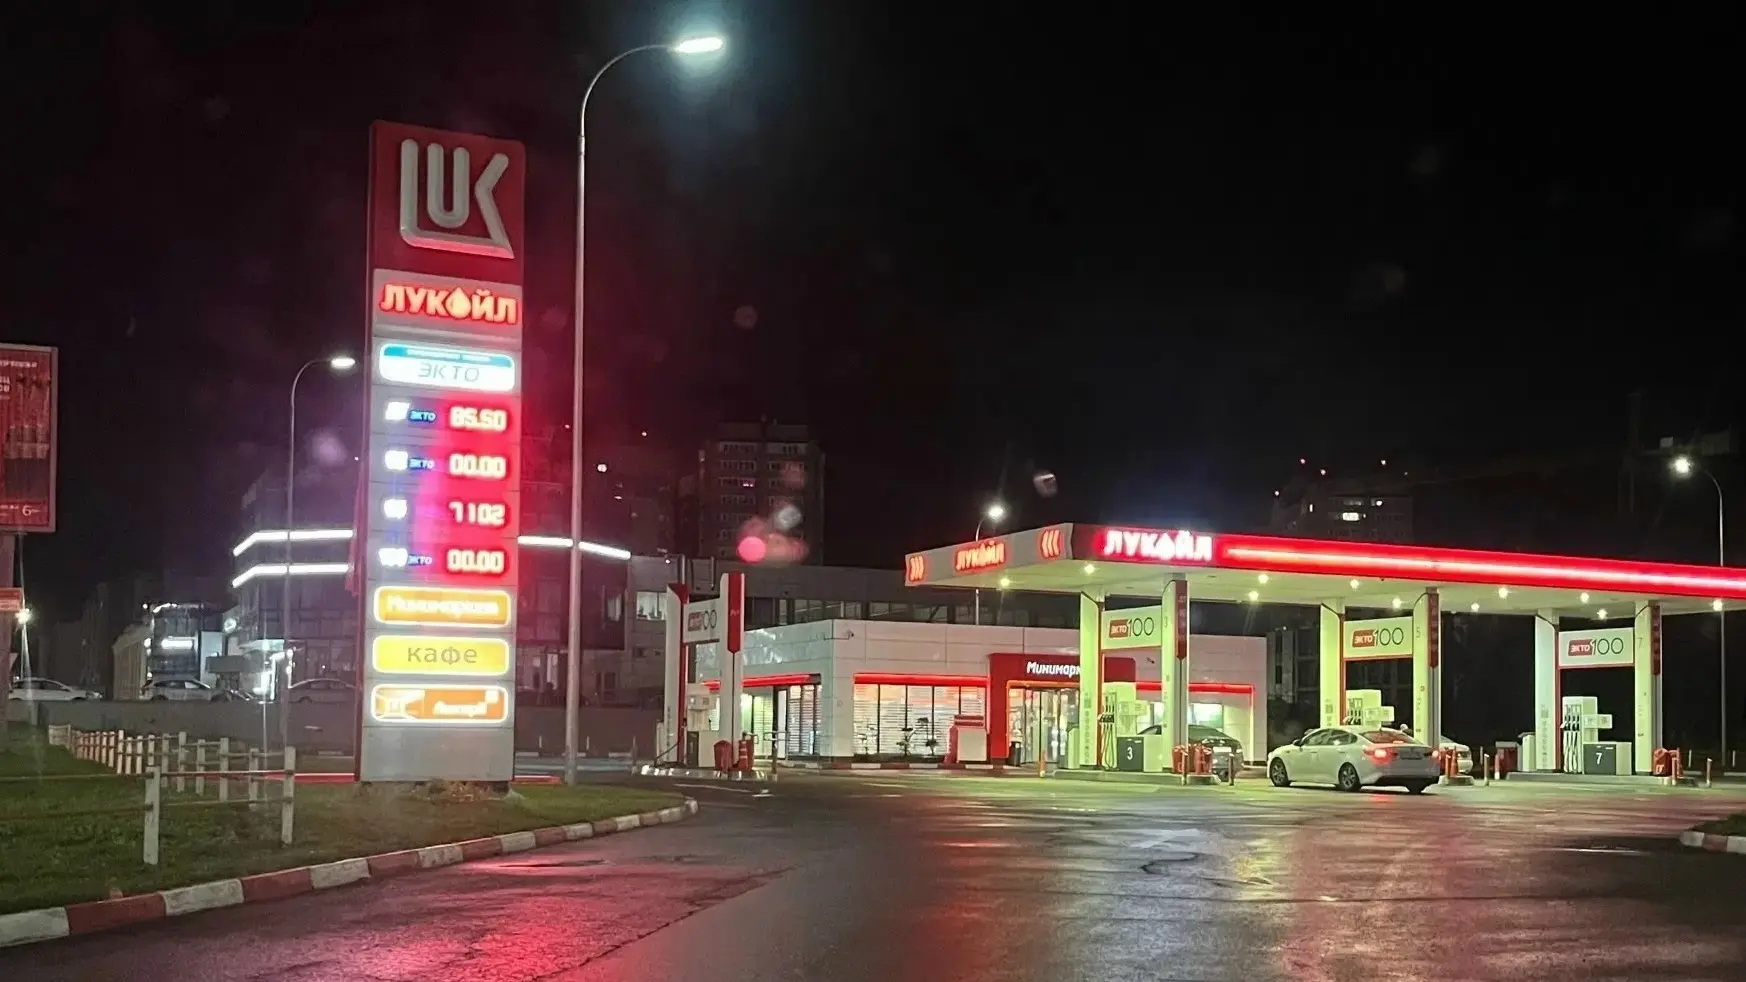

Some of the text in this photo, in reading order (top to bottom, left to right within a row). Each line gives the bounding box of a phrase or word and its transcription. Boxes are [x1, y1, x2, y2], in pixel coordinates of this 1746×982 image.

[1128, 616, 1155, 637] 100
[1374, 627, 1404, 646] 100
[407, 646, 478, 665] кафе
[1570, 637, 1624, 656] ЭКТО 100
[1126, 746, 1133, 760] 3
[1595, 752, 1602, 765] 7
